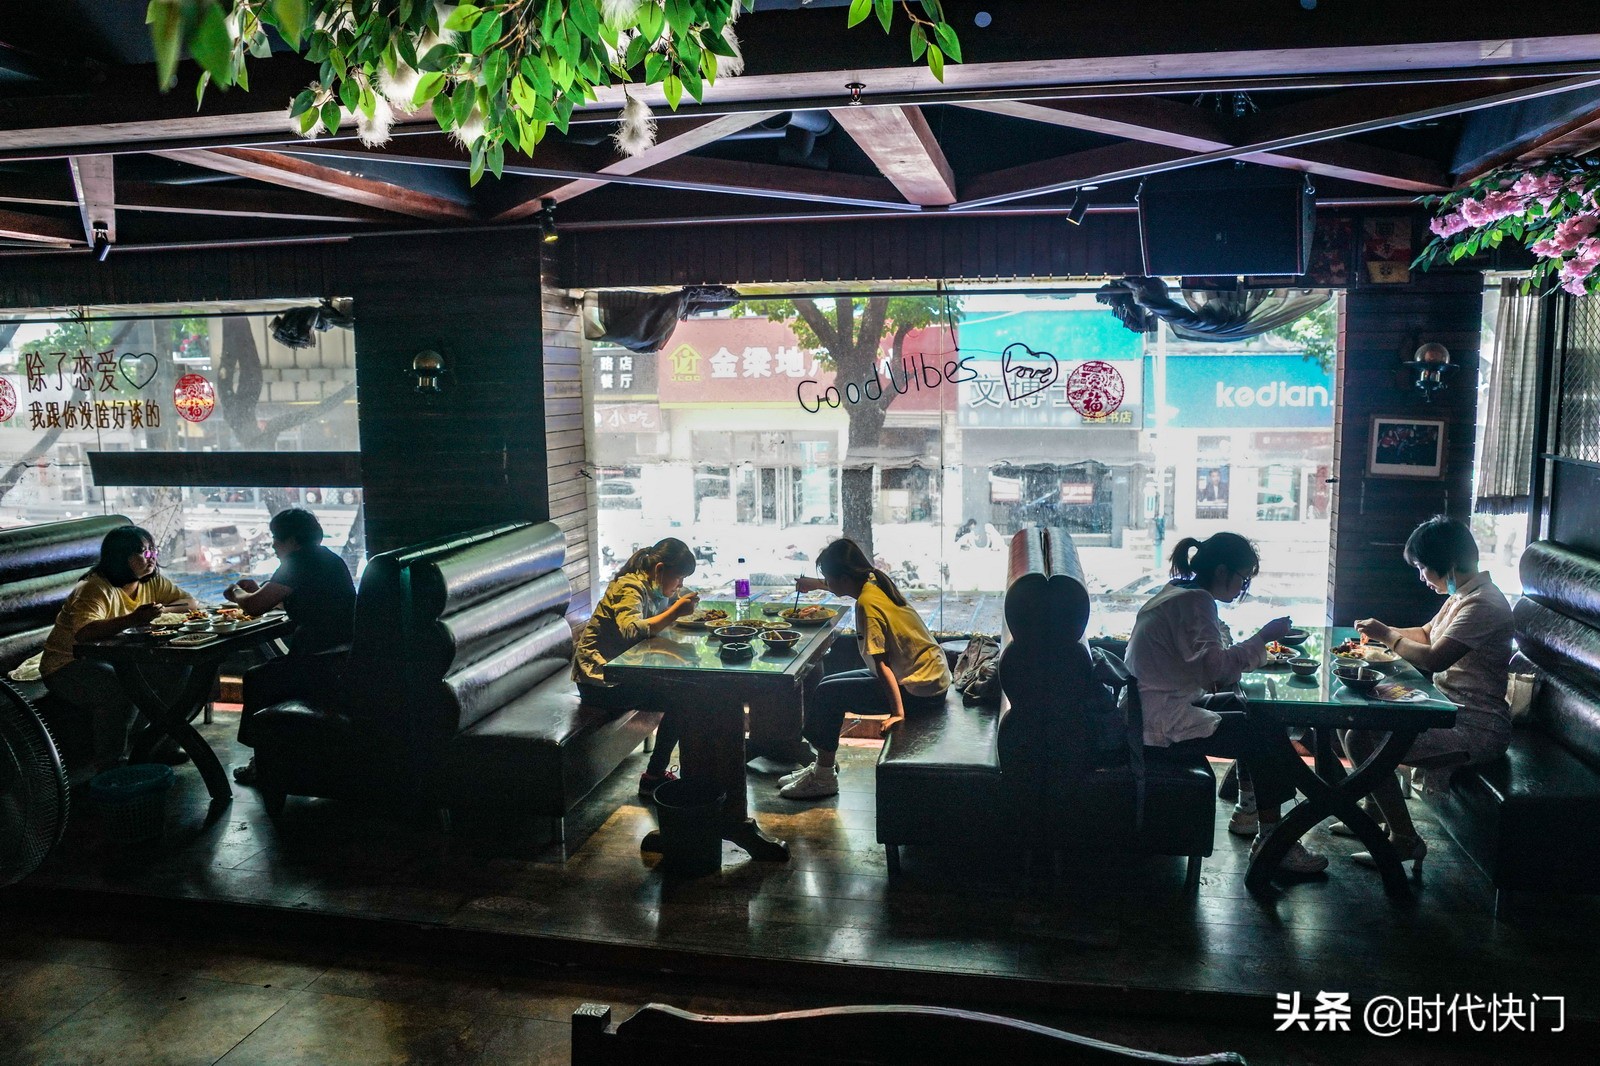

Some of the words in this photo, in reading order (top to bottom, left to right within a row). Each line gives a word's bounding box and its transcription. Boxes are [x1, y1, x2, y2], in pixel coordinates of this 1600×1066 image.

[25, 349, 119, 393] 除了恋爱
[600, 373, 633, 389] 餐厅
[797, 362, 882, 413] Good
[28, 398, 161, 431] 我跟你没啥好谈的
[608, 408, 656, 430] 小吃
